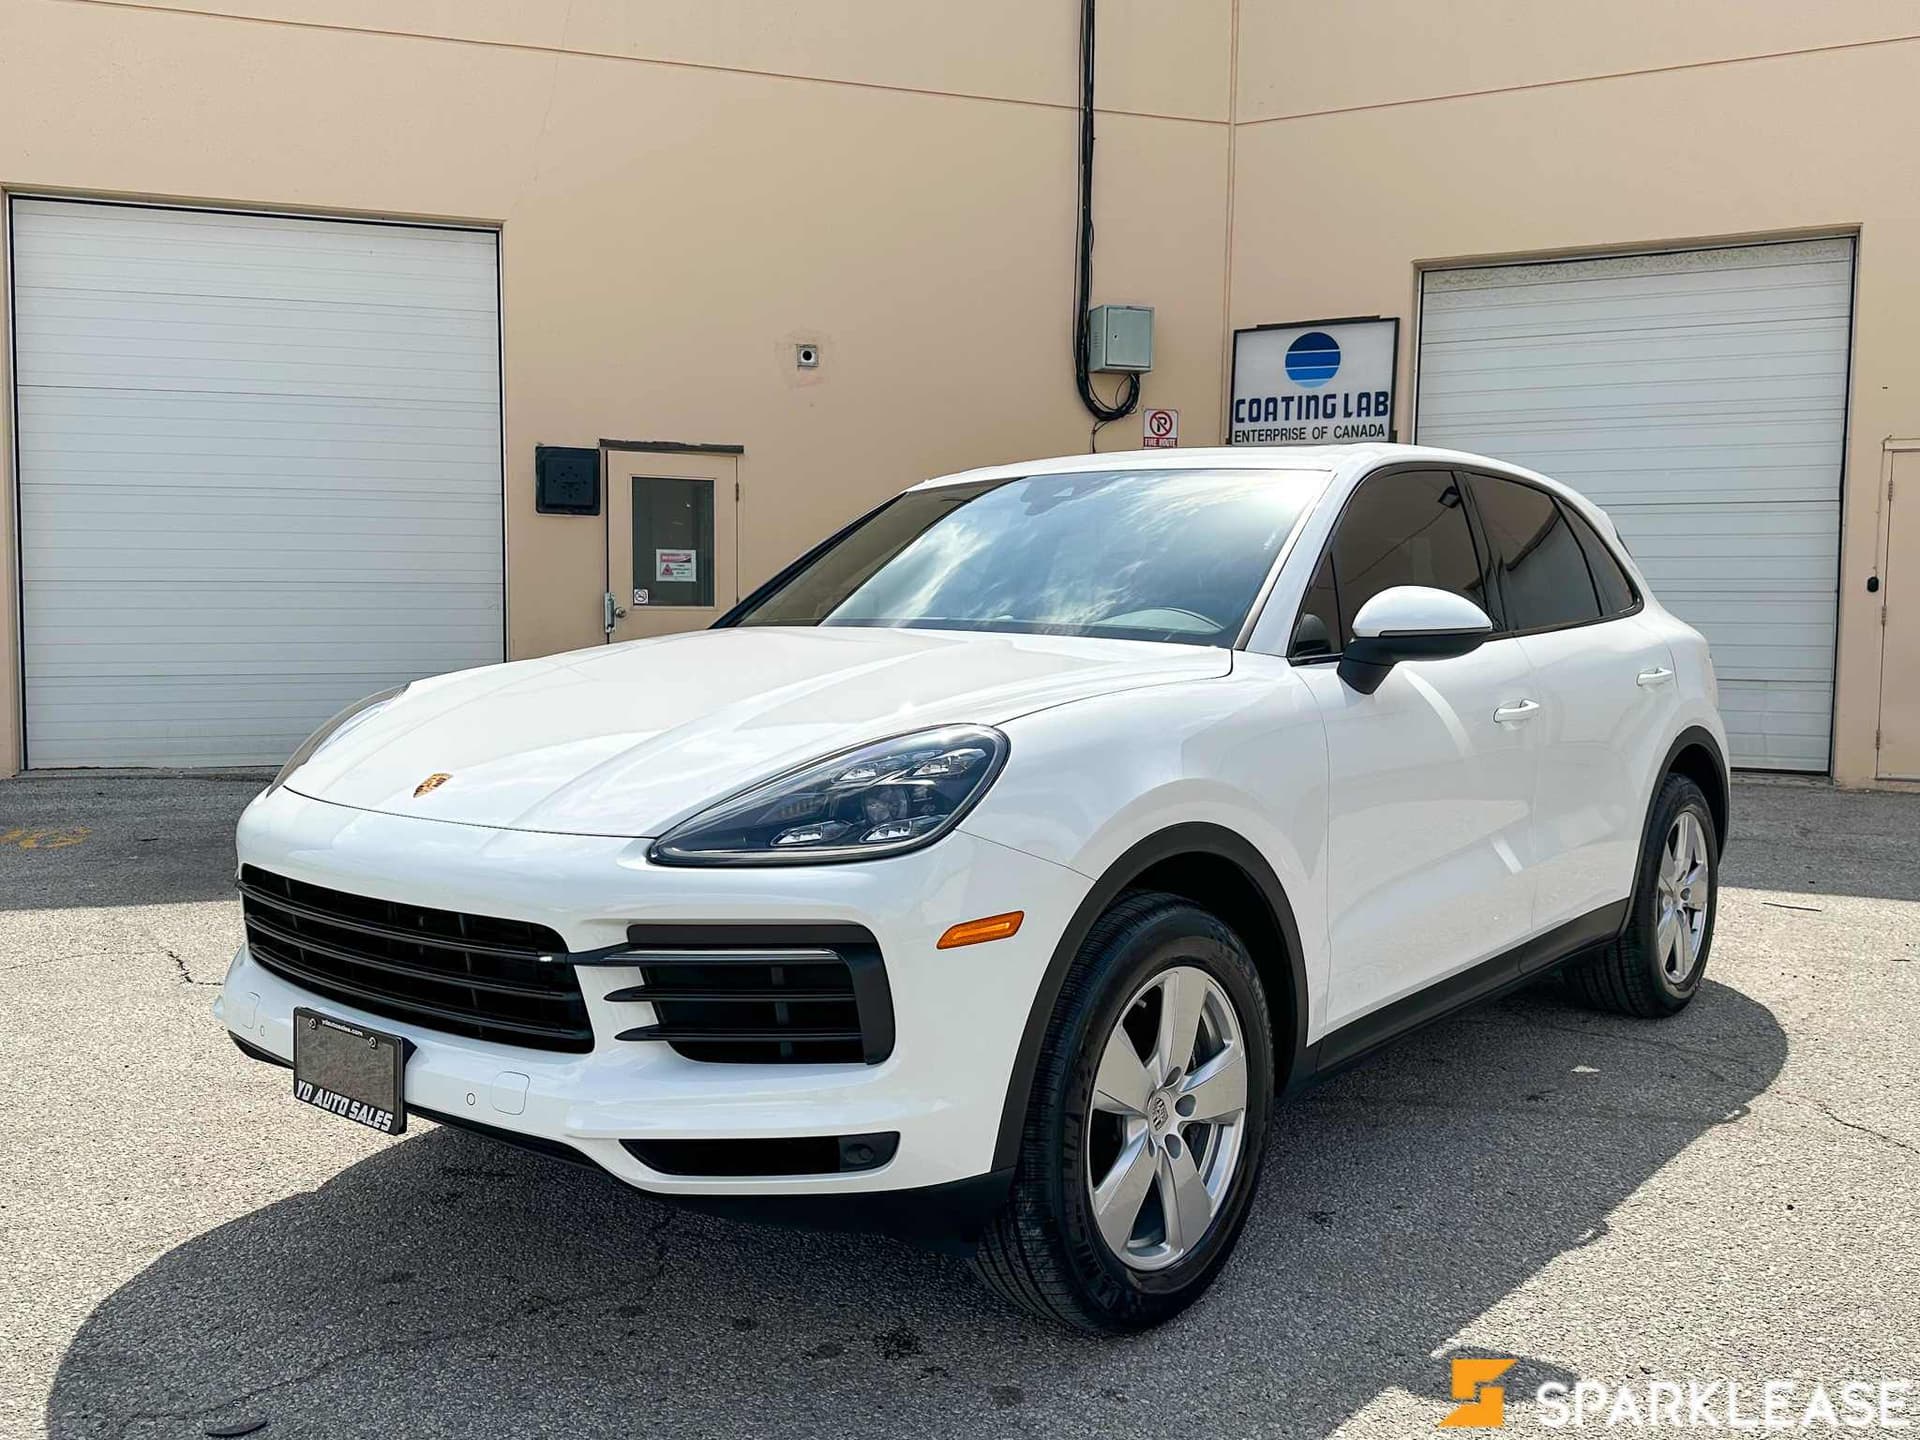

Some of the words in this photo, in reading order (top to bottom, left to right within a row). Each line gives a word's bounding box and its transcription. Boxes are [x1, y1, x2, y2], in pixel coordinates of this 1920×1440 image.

[1234, 394, 1337, 423] COATING
[1343, 391, 1389, 418] LAB
[1234, 427, 1307, 443] ENTERPRISE
[1312, 426, 1328, 440] OF
[1333, 423, 1385, 439] CANADA
[296, 1080, 313, 1099] YD
[312, 1088, 350, 1116] AUTO
[348, 1101, 394, 1131] SALES
